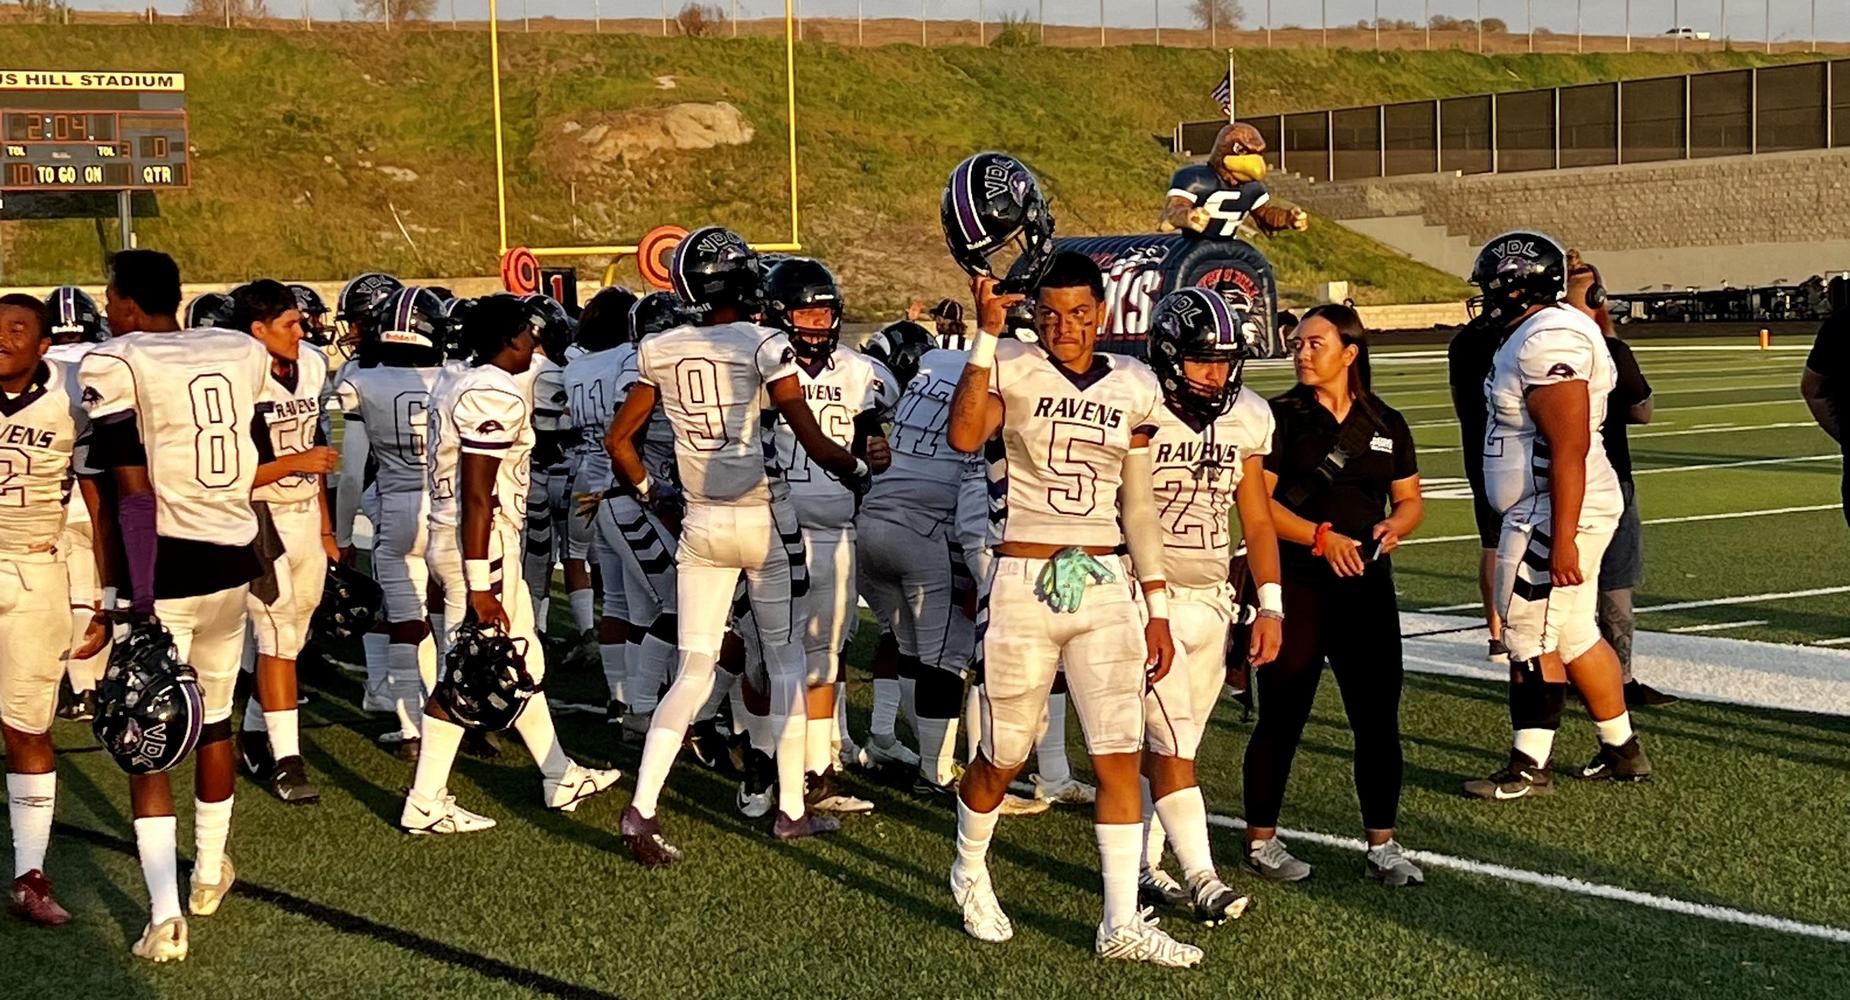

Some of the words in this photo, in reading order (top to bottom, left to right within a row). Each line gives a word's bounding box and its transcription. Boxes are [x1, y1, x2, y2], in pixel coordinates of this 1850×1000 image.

[0, 74, 18, 85] S
[26, 74, 73, 86] HILL
[80, 74, 173, 87] STADIUM
[7, 145, 26, 157] TOL
[97, 145, 116, 157] TOL
[37, 166, 55, 184] TO
[58, 166, 77, 184] GO
[84, 166, 102, 183] ON
[143, 166, 171, 183] QTR
[1491, 240, 1539, 260] VDL
[550, 274, 564, 305] 1
[800, 384, 842, 401] VENS
[675, 357, 729, 451] 9
[1034, 396, 1123, 429] RAVENS
[188, 373, 240, 489] 8
[1048, 420, 1106, 517] 5
